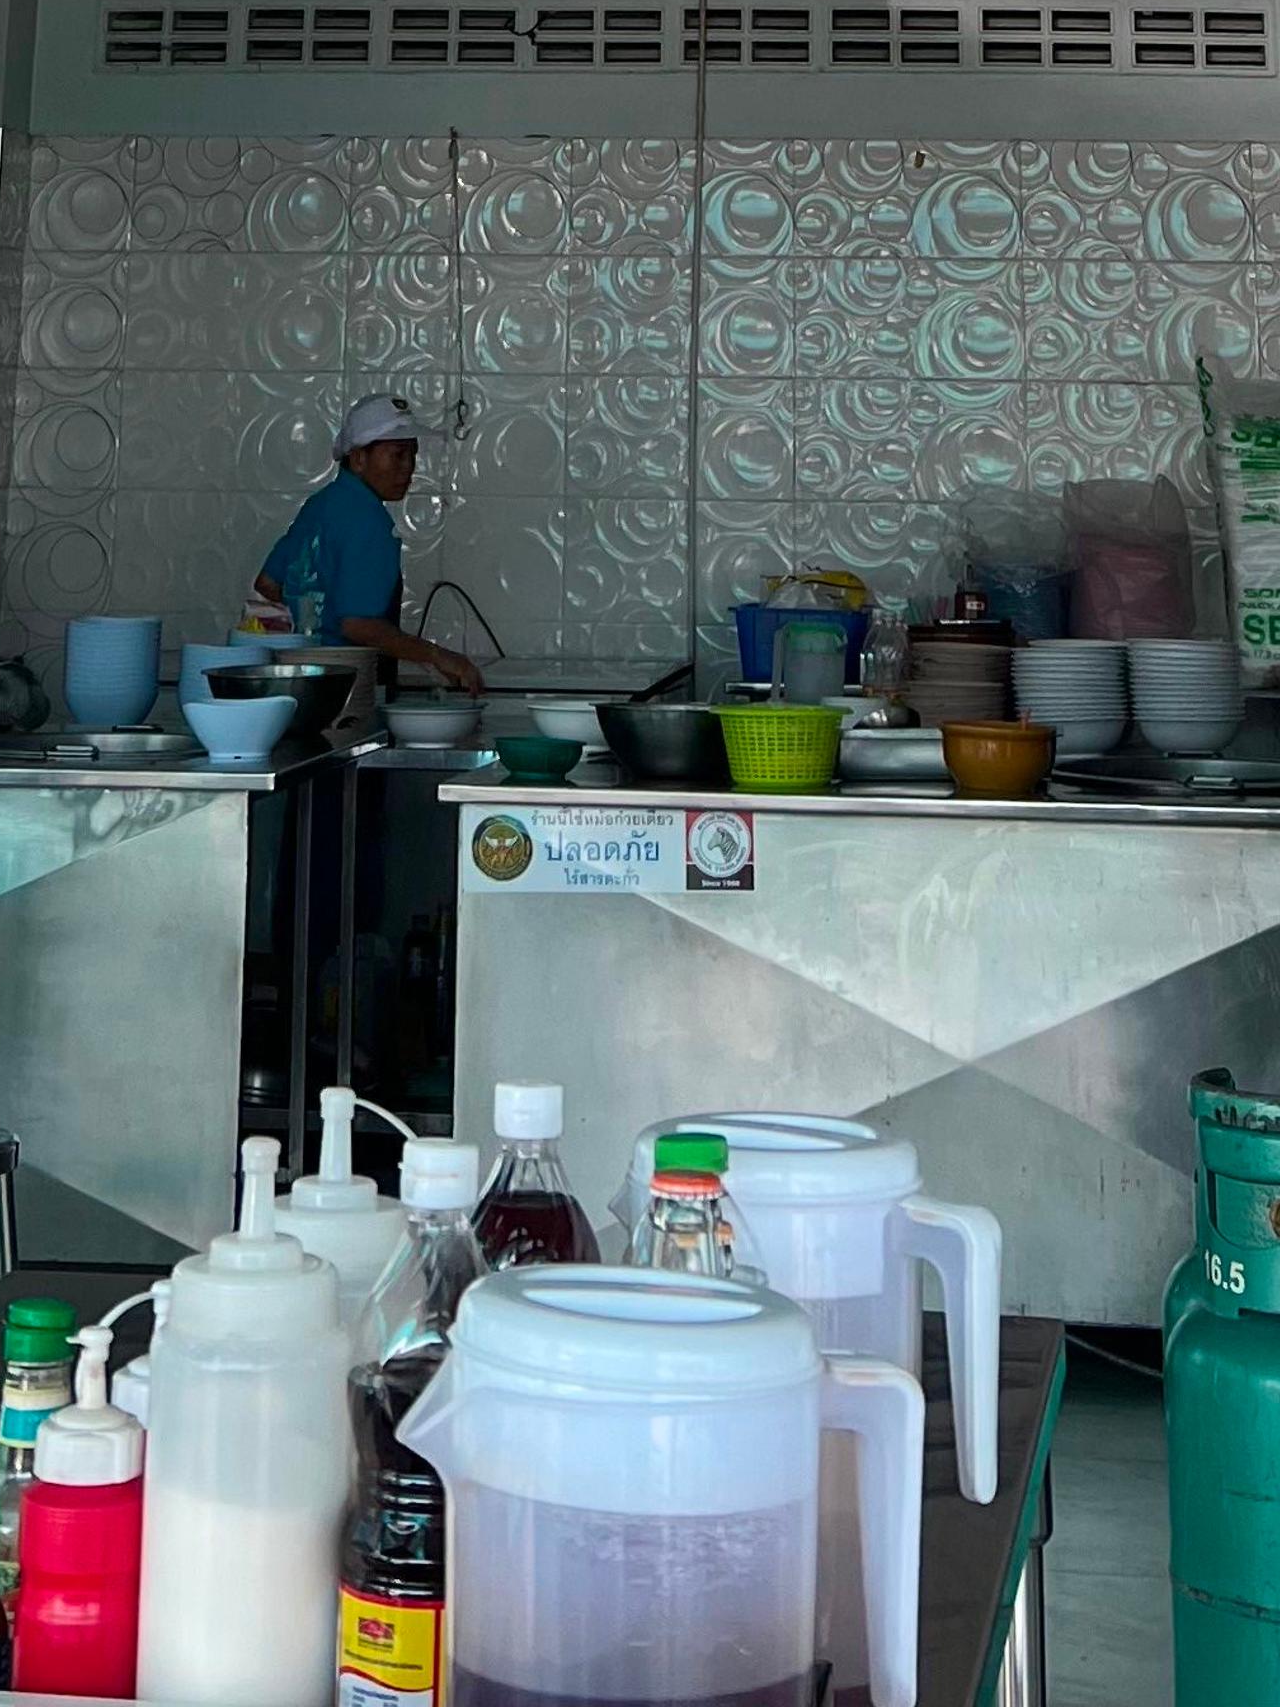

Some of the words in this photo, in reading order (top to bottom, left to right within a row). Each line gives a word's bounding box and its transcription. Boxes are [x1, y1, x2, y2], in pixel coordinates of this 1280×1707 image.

[545, 830, 660, 862] ปลอดภัย
[1204, 1249, 1246, 1295] 16.5
